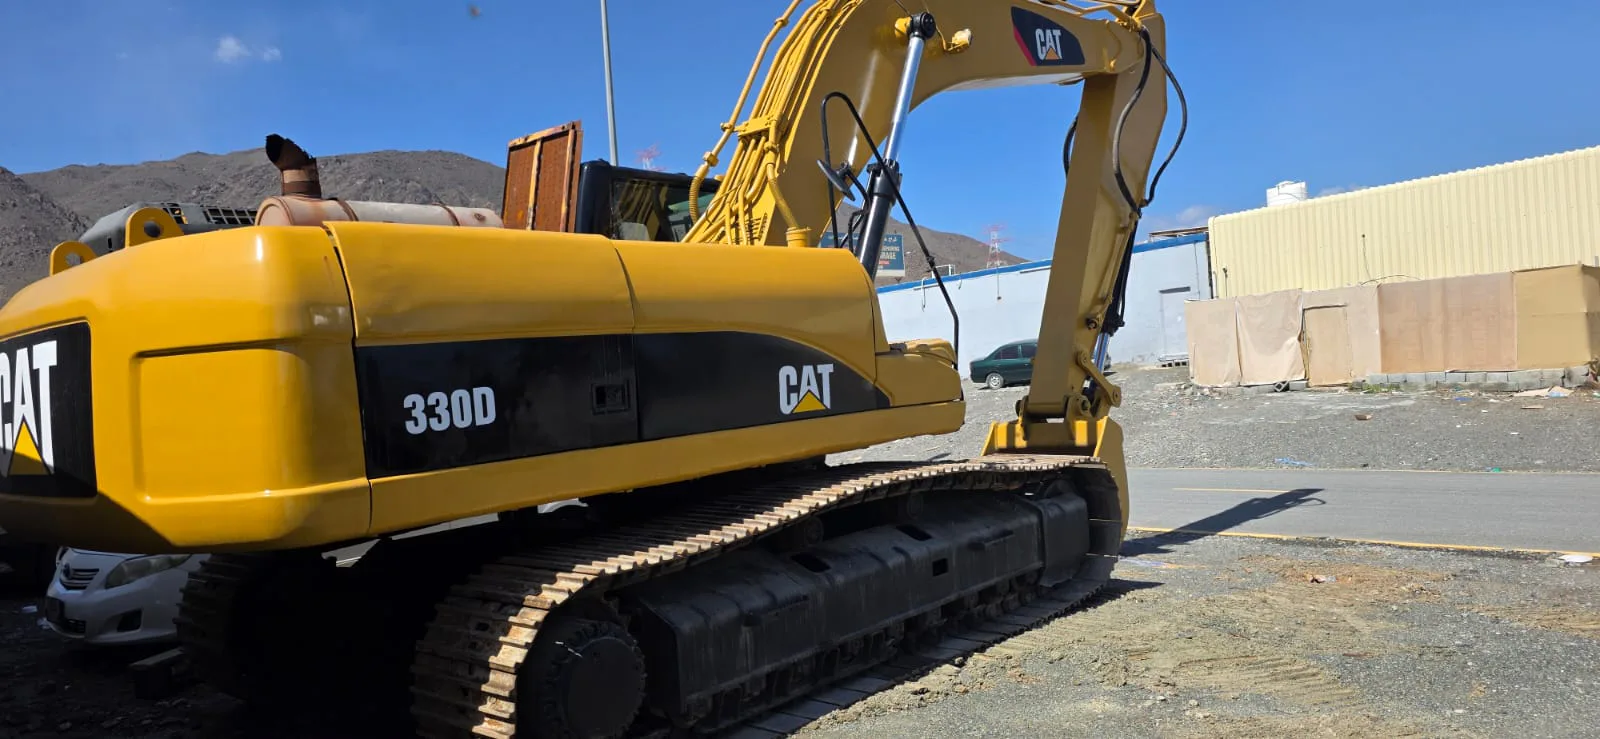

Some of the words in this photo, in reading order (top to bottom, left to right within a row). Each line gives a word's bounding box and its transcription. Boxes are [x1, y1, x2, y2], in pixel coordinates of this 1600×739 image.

[1035, 28, 1062, 60] CAT
[403, 386, 496, 434] 330D
[779, 363, 834, 415] CAT
